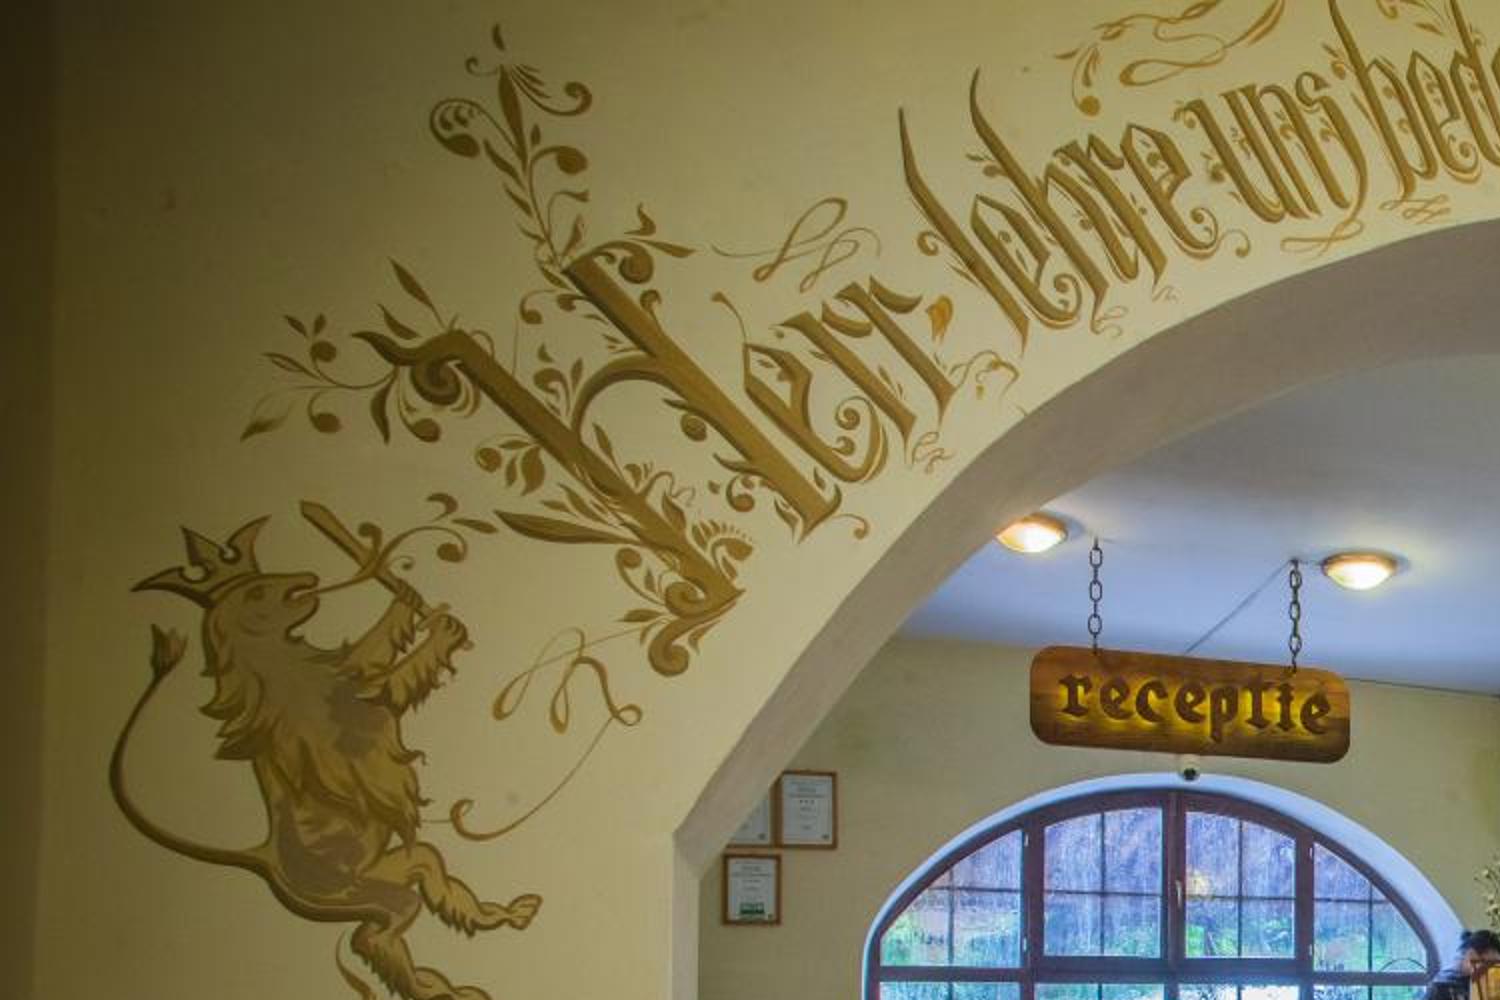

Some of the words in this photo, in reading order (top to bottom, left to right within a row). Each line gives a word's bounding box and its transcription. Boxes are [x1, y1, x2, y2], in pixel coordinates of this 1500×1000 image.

[898, 66, 1218, 358] lehre
[1188, 72, 1369, 224] uns
[1059, 672, 1331, 743] receptie
